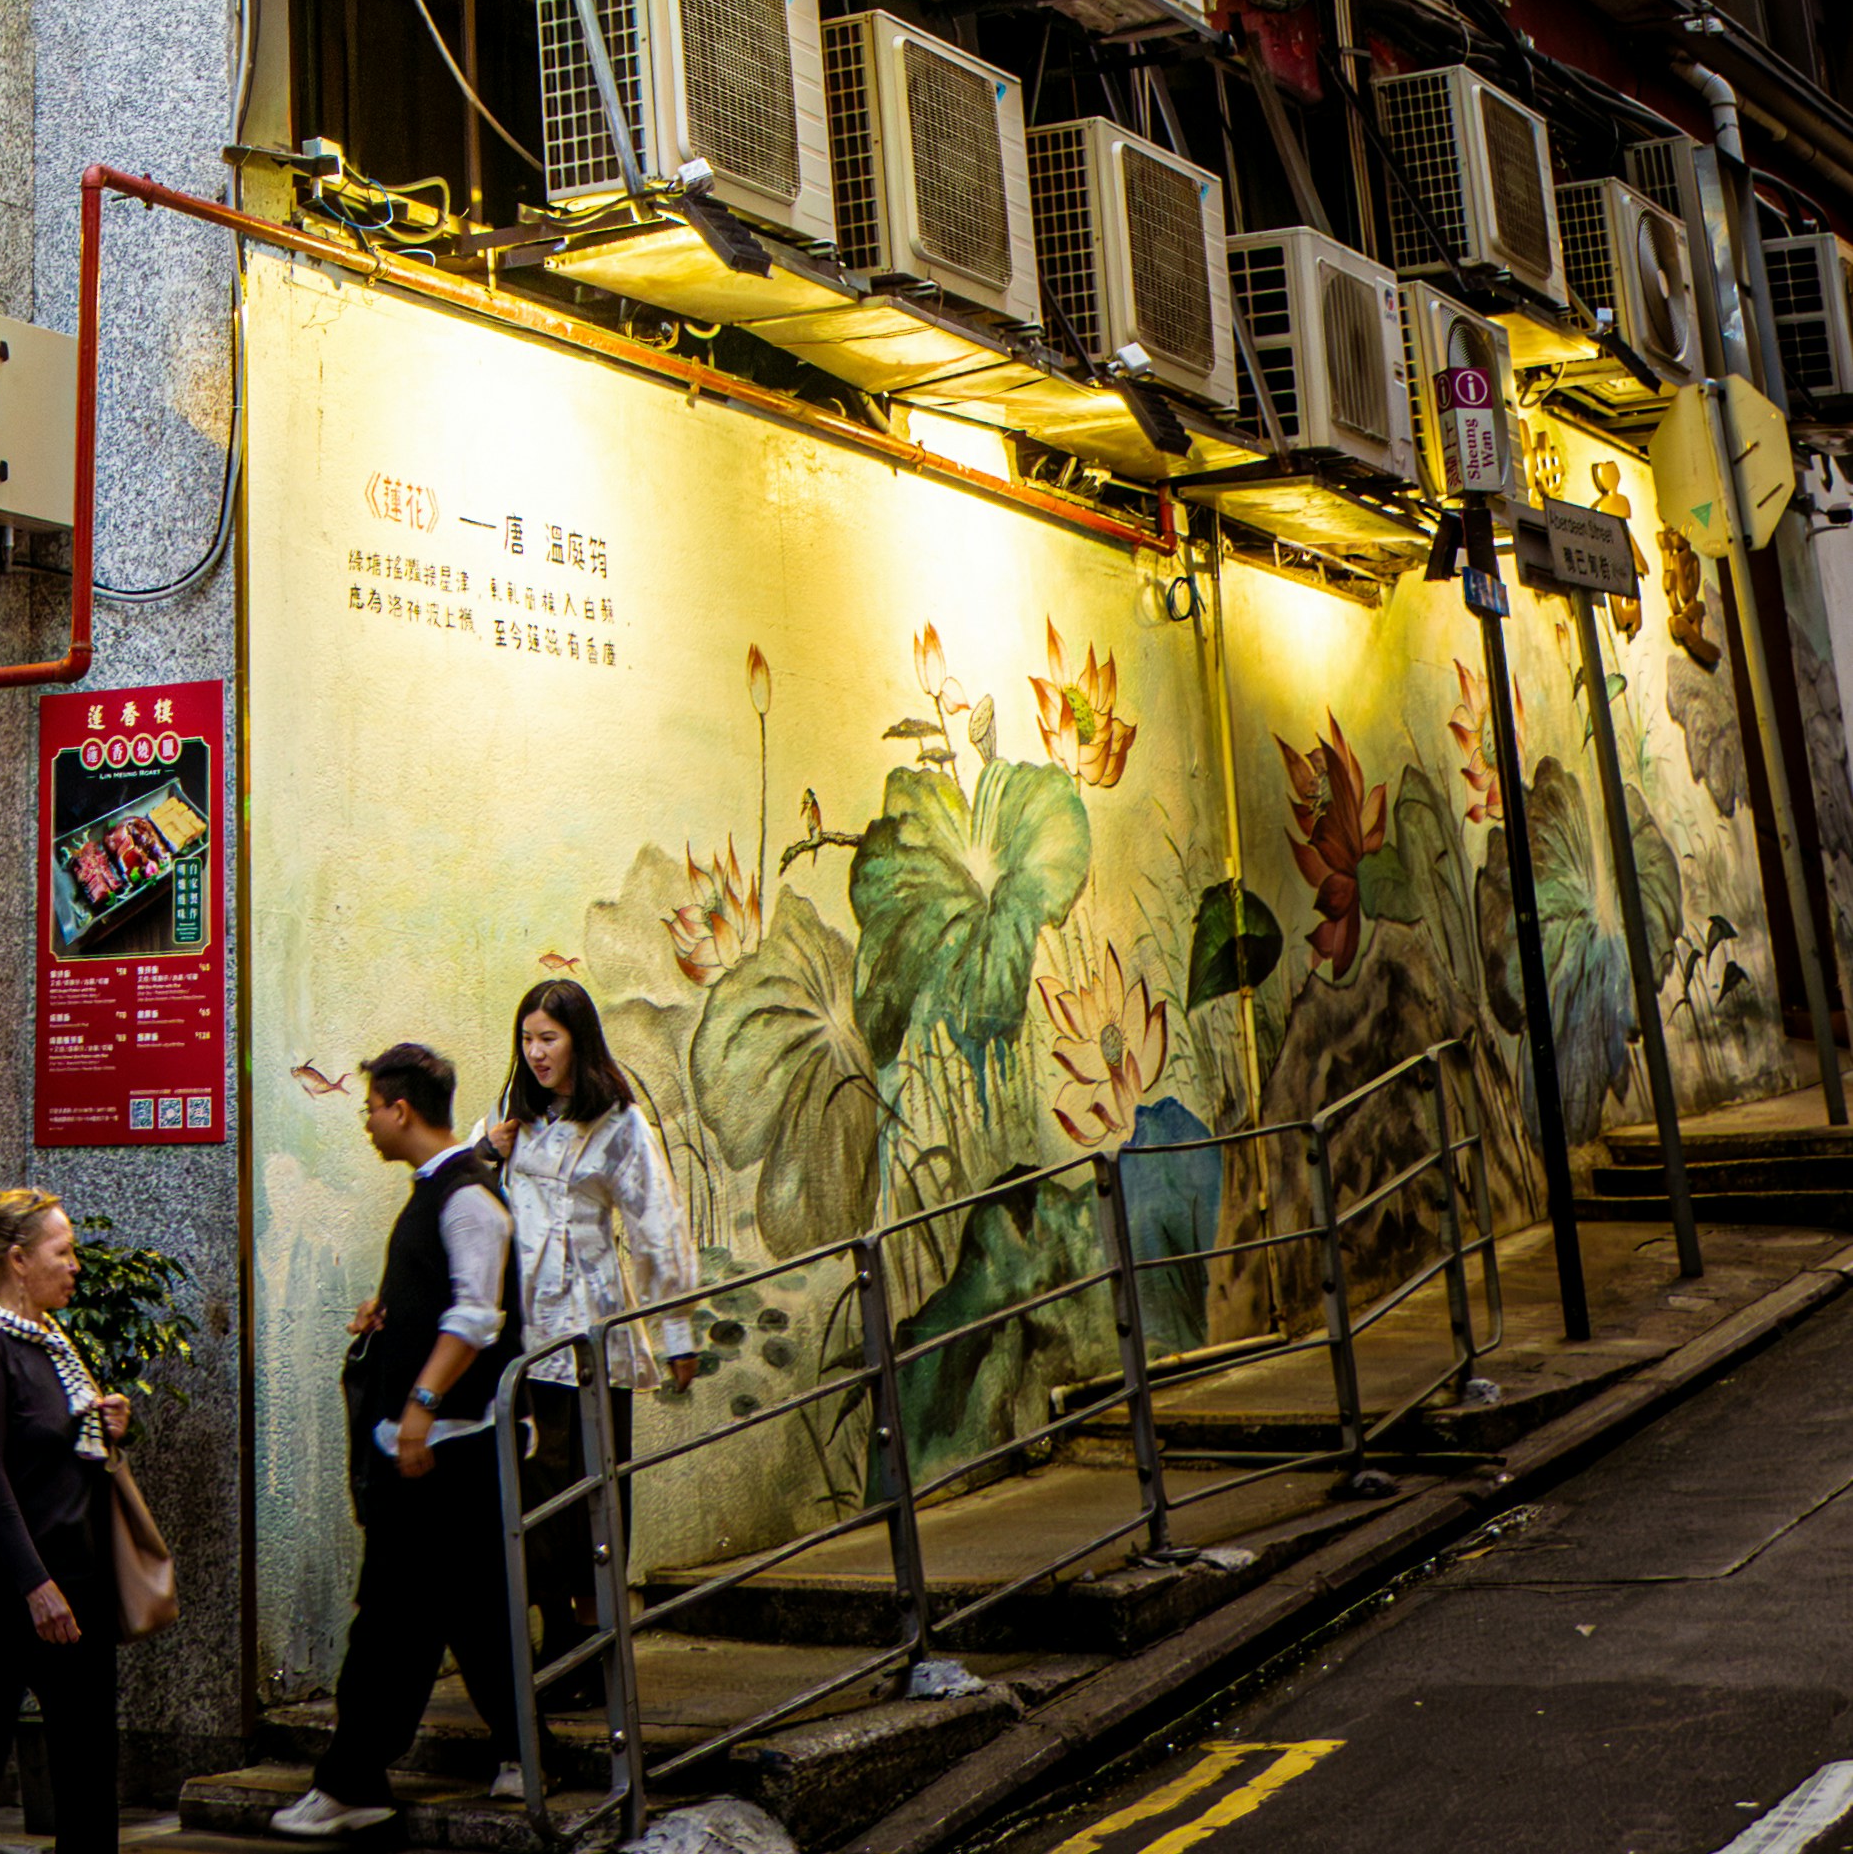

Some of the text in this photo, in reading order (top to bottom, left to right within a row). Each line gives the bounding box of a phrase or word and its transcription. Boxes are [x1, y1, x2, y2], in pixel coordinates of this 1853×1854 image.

[1464, 418, 1481, 481] Sheung
[1481, 429, 1495, 469] Wan
[1587, 518, 1616, 545] Street
[87, 697, 175, 731] 蓮香樓
